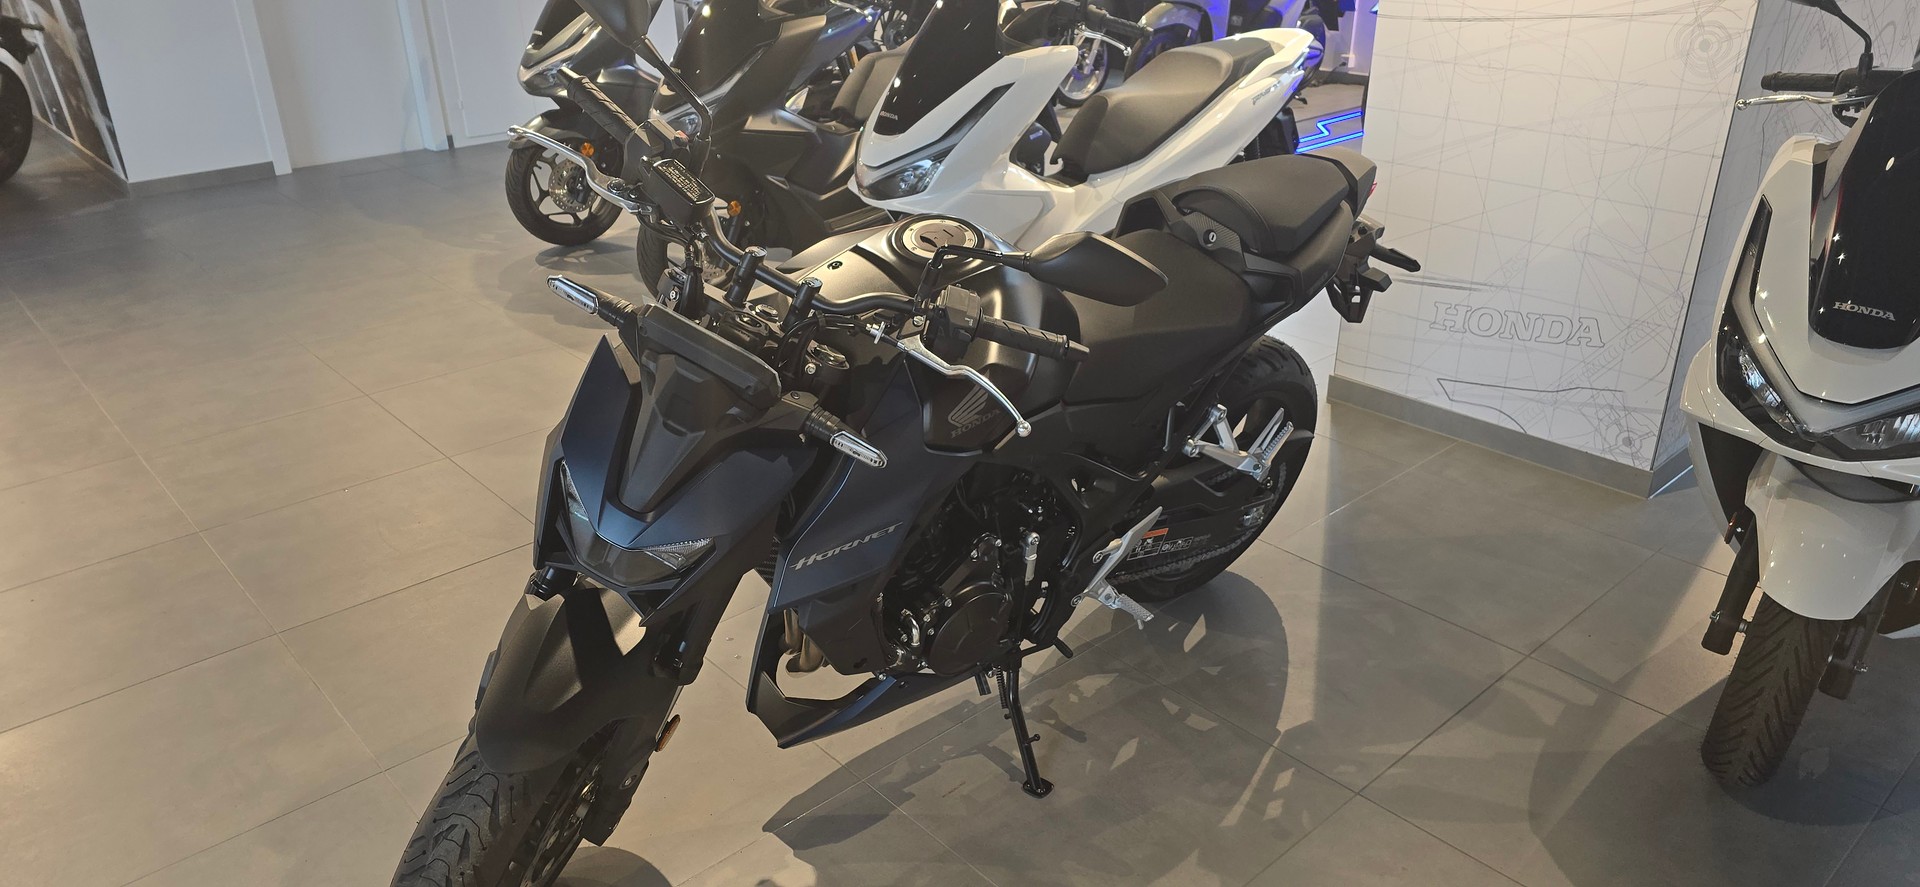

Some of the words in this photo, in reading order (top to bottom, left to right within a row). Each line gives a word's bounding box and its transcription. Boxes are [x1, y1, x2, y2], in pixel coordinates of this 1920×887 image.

[1429, 301, 1605, 348] HONDA
[1832, 301, 1896, 322] HONDA
[950, 408, 1001, 439] HONDA
[789, 521, 904, 571] HORNET
